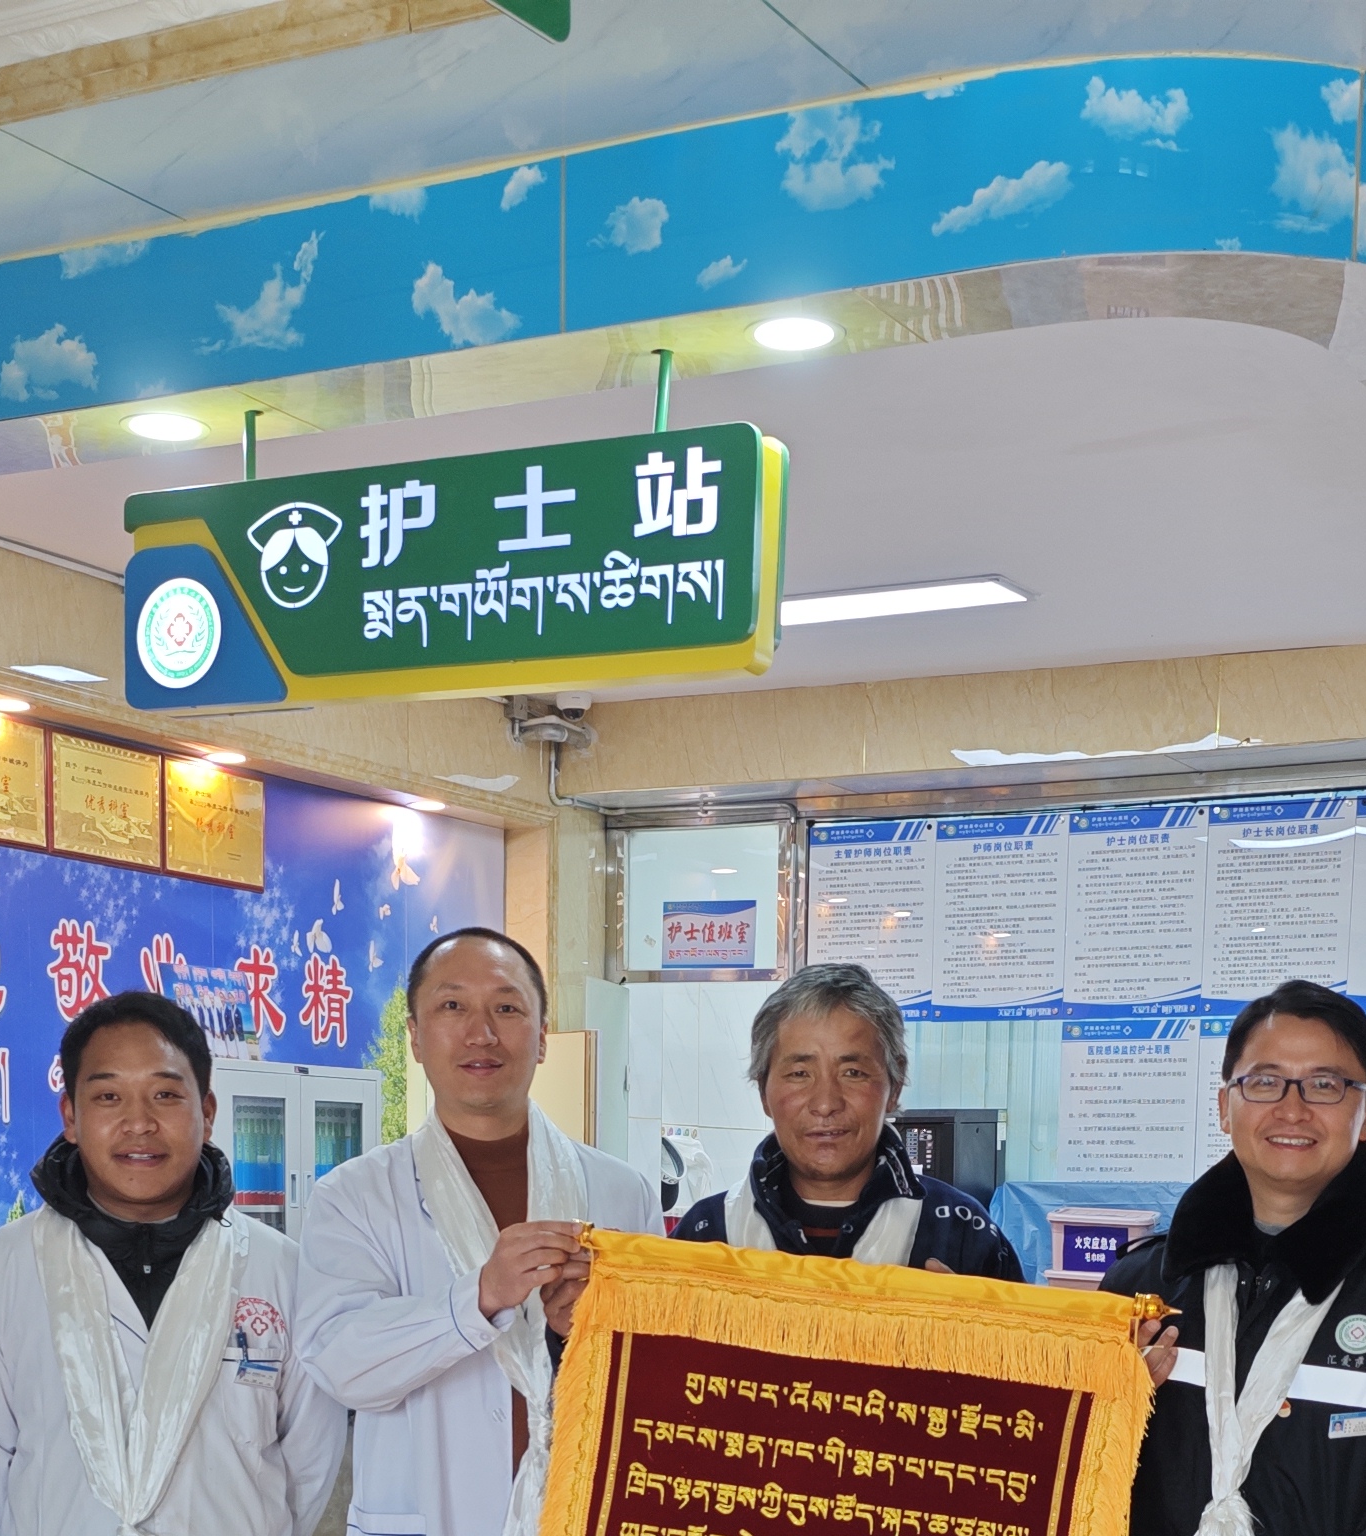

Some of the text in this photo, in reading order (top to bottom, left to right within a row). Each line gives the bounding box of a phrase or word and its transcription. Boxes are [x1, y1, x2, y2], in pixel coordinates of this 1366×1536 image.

[360, 446, 722, 569] 护士站
[85, 794, 129, 819] 优秀科室
[1106, 834, 1170, 847] 护士岗位职责
[1242, 824, 1320, 838] 护士长岗位职责
[834, 846, 912, 859] 主管护师岗位职责
[972, 841, 1034, 853] 护师岗位职责
[667, 920, 750, 944] 护士值班室
[235, 944, 353, 1048] 求精
